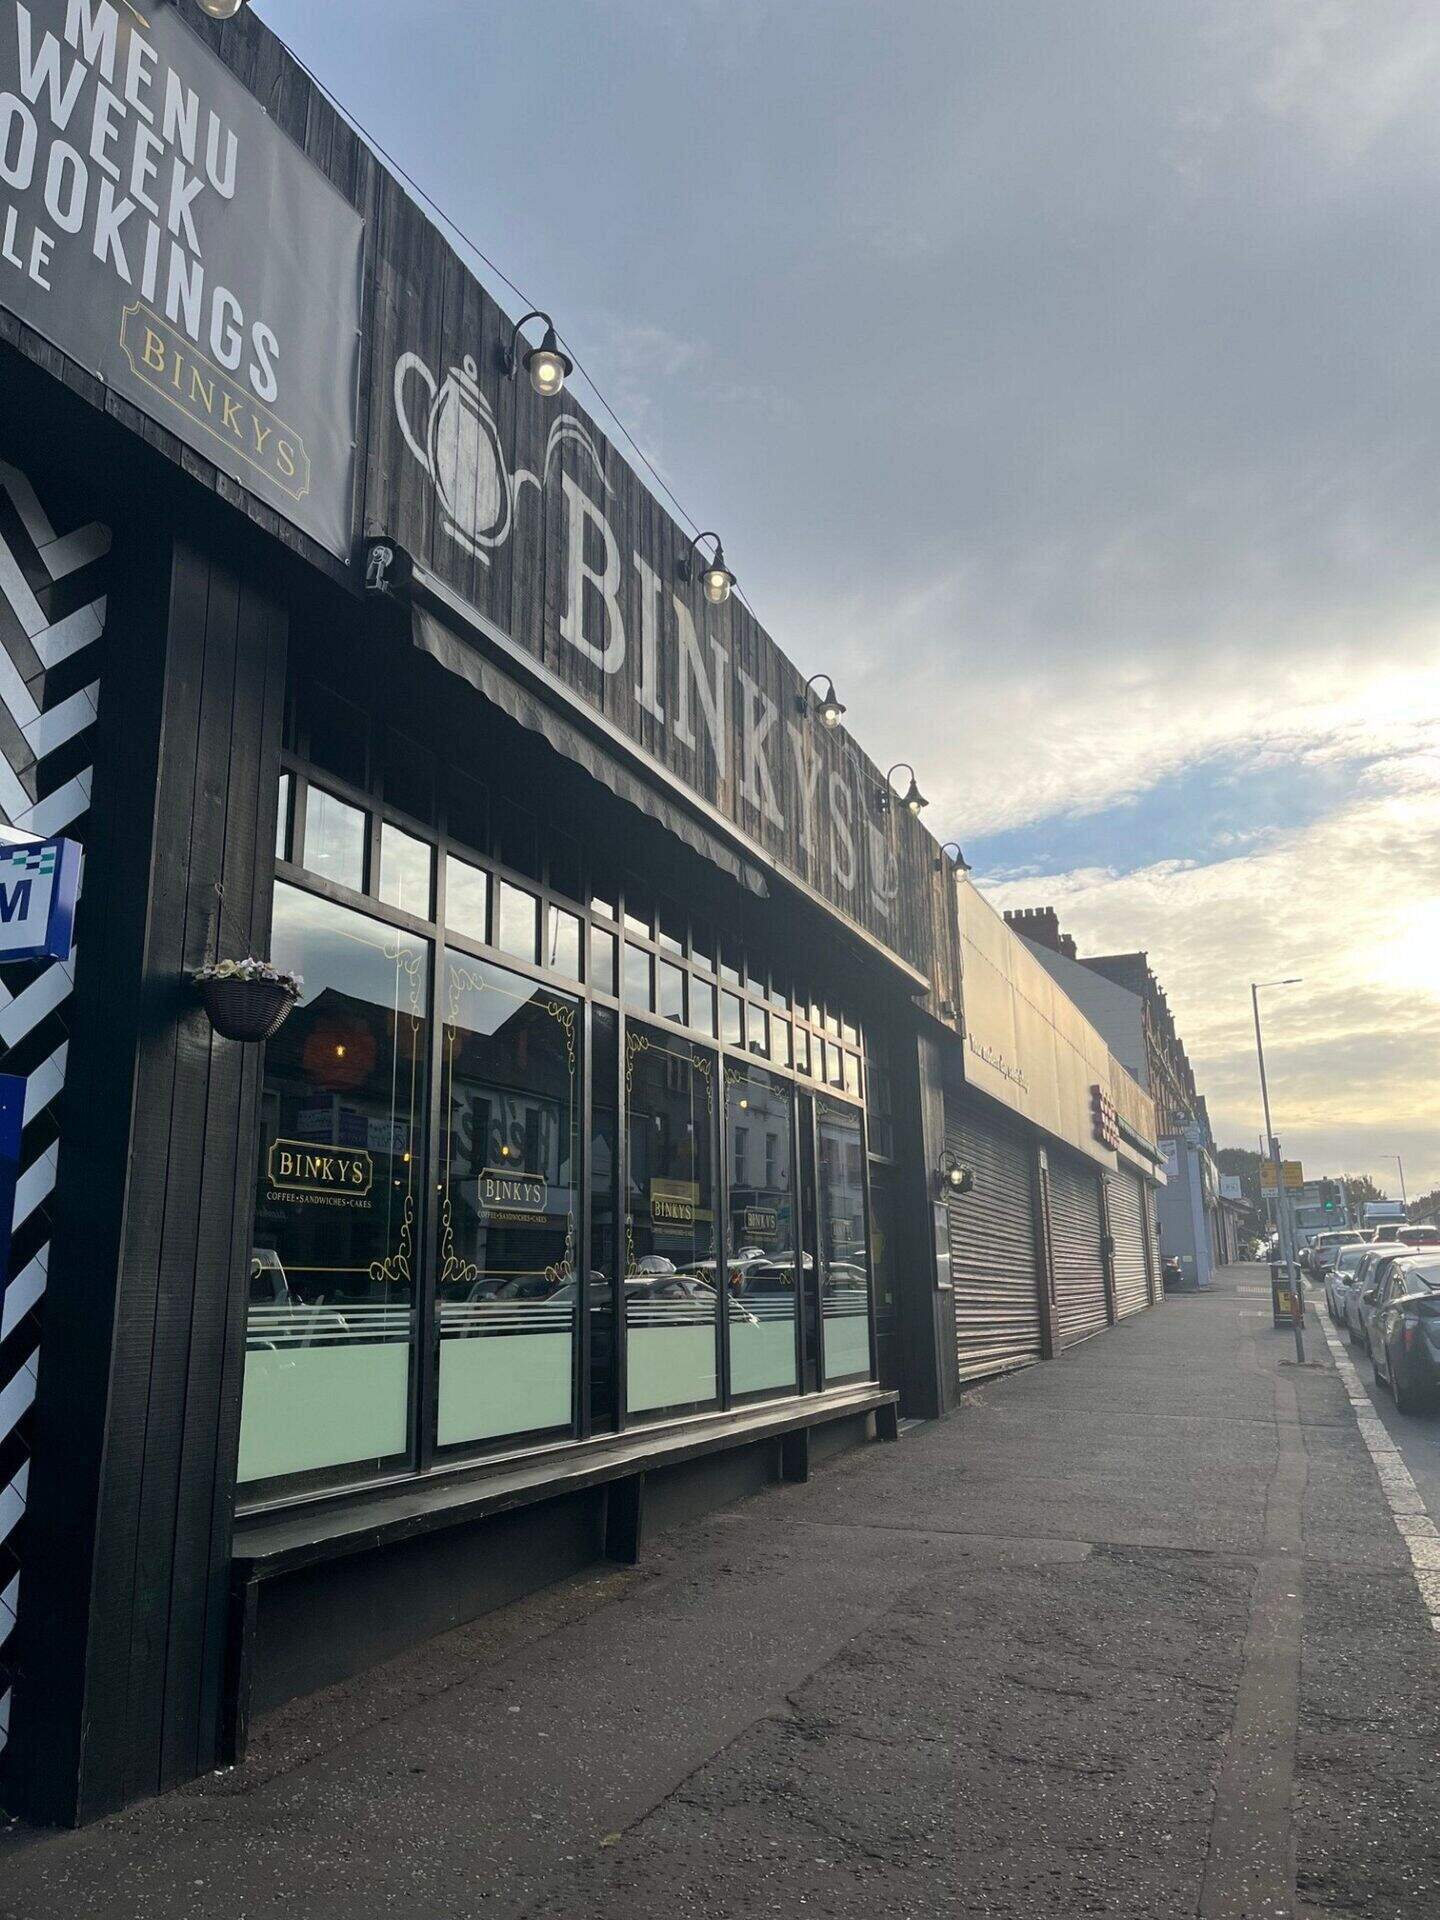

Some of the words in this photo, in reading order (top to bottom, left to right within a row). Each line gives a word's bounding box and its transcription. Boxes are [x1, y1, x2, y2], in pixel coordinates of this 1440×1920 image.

[16, 1, 205, 259] WEEK
[64, 0, 238, 199] MENU
[2, 205, 56, 291] LE
[143, 327, 296, 477] BINKYS
[559, 470, 855, 892] BINKYS
[280, 1151, 363, 1184] BINKYS
[486, 1179, 541, 1203] BINKYS
[654, 1201, 692, 1220] BINKYS
[747, 1212, 776, 1229] BINKYS
